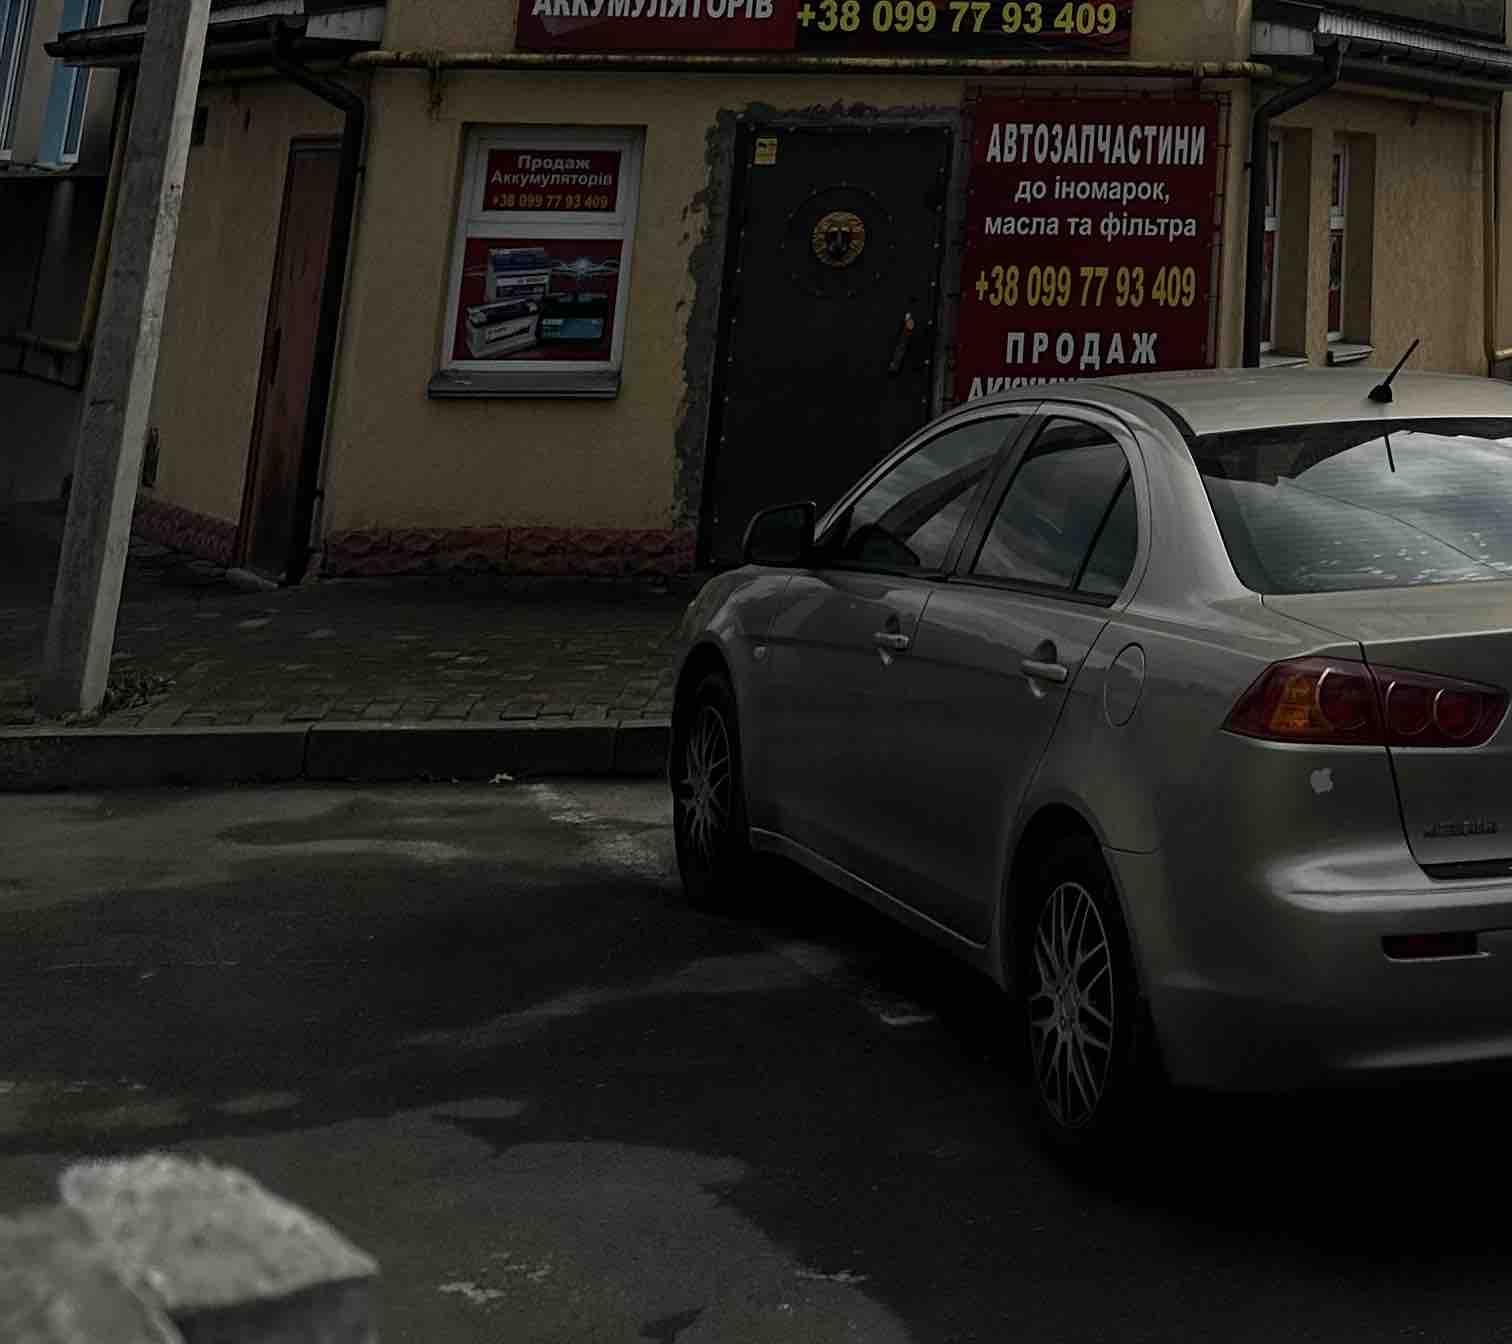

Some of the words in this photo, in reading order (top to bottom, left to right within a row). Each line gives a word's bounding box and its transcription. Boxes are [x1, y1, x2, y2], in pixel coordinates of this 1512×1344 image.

[799, 0, 861, 34] +38
[871, 0, 937, 33] 099
[949, 1, 991, 33] 77
[1001, 2, 1044, 34] 93
[1053, 2, 1118, 35] 409
[986, 123, 1206, 165] АВТОЗАПЧАСТИНИ
[517, 154, 592, 171] Продаж
[518, 193, 544, 208] 099
[544, 194, 562, 209] 77
[1014, 179, 1047, 203] до
[1054, 176, 1170, 205] іномарок,
[984, 215, 1059, 236] масла
[1067, 217, 1092, 236] та
[1100, 212, 1197, 242] фільтра
[975, 265, 1019, 307] +38
[1026, 266, 1072, 307] 099
[1079, 267, 1109, 307] 77
[1115, 267, 1144, 307] 93
[1151, 266, 1196, 307] 409
[1005, 332, 1158, 371] ПРОДАЖ
